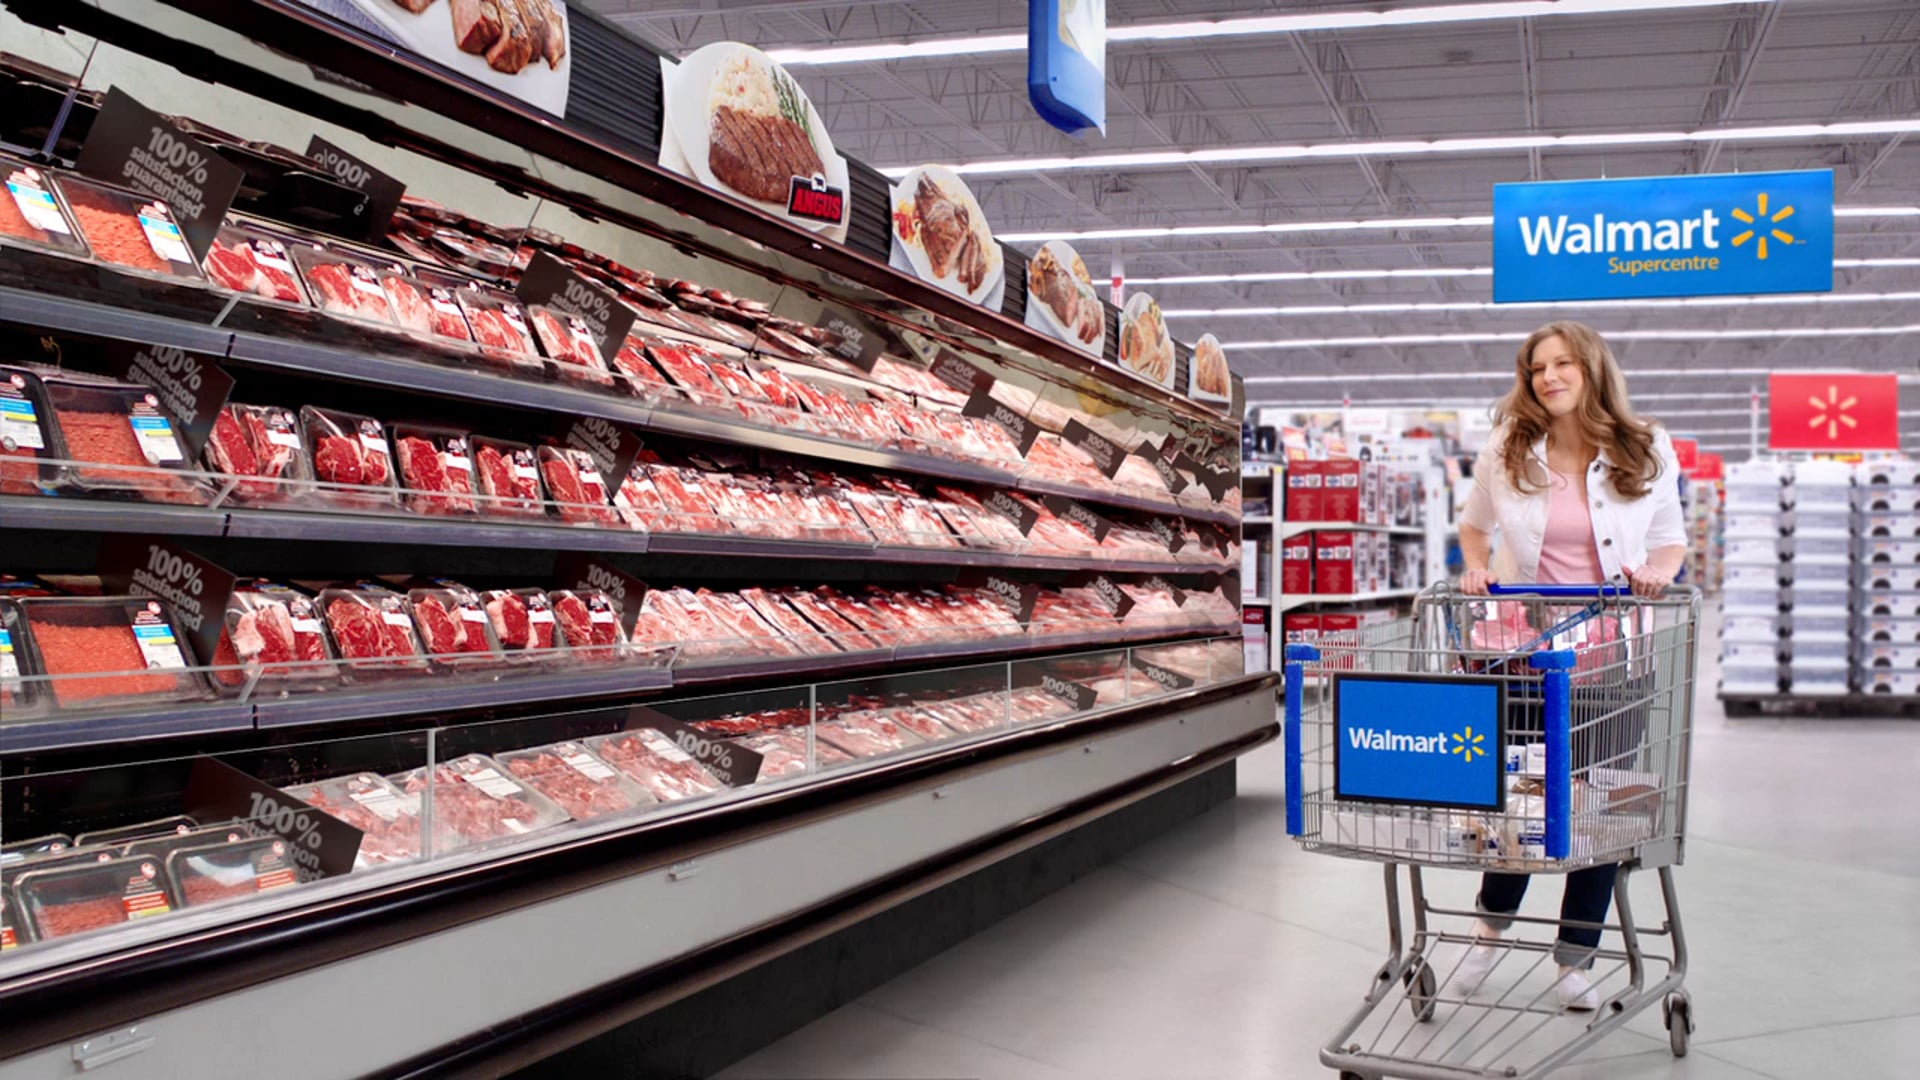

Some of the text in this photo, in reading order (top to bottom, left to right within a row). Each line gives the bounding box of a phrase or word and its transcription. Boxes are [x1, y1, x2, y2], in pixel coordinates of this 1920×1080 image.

[130, 146, 203, 202] satisfaction
[148, 126, 208, 184] 100%
[122, 160, 206, 219] guaranteed
[792, 187, 841, 220] ANGUS
[1518, 209, 1720, 256] Walmart
[1608, 256, 1720, 277] Supercentre
[564, 278, 611, 322] 100%
[133, 351, 197, 409] satisfaction
[993, 406, 1025, 433] 100%
[992, 491, 1023, 518] 100%
[1069, 505, 1097, 528] 100%
[148, 544, 204, 595] 100%
[587, 564, 625, 599] 100%
[987, 577, 1021, 600] 100%
[132, 568, 201, 614] satisfaction
[1041, 675, 1079, 701] 100%
[674, 729, 732, 769] 100%
[1348, 727, 1448, 754] Walmart
[249, 792, 322, 849] 100%
